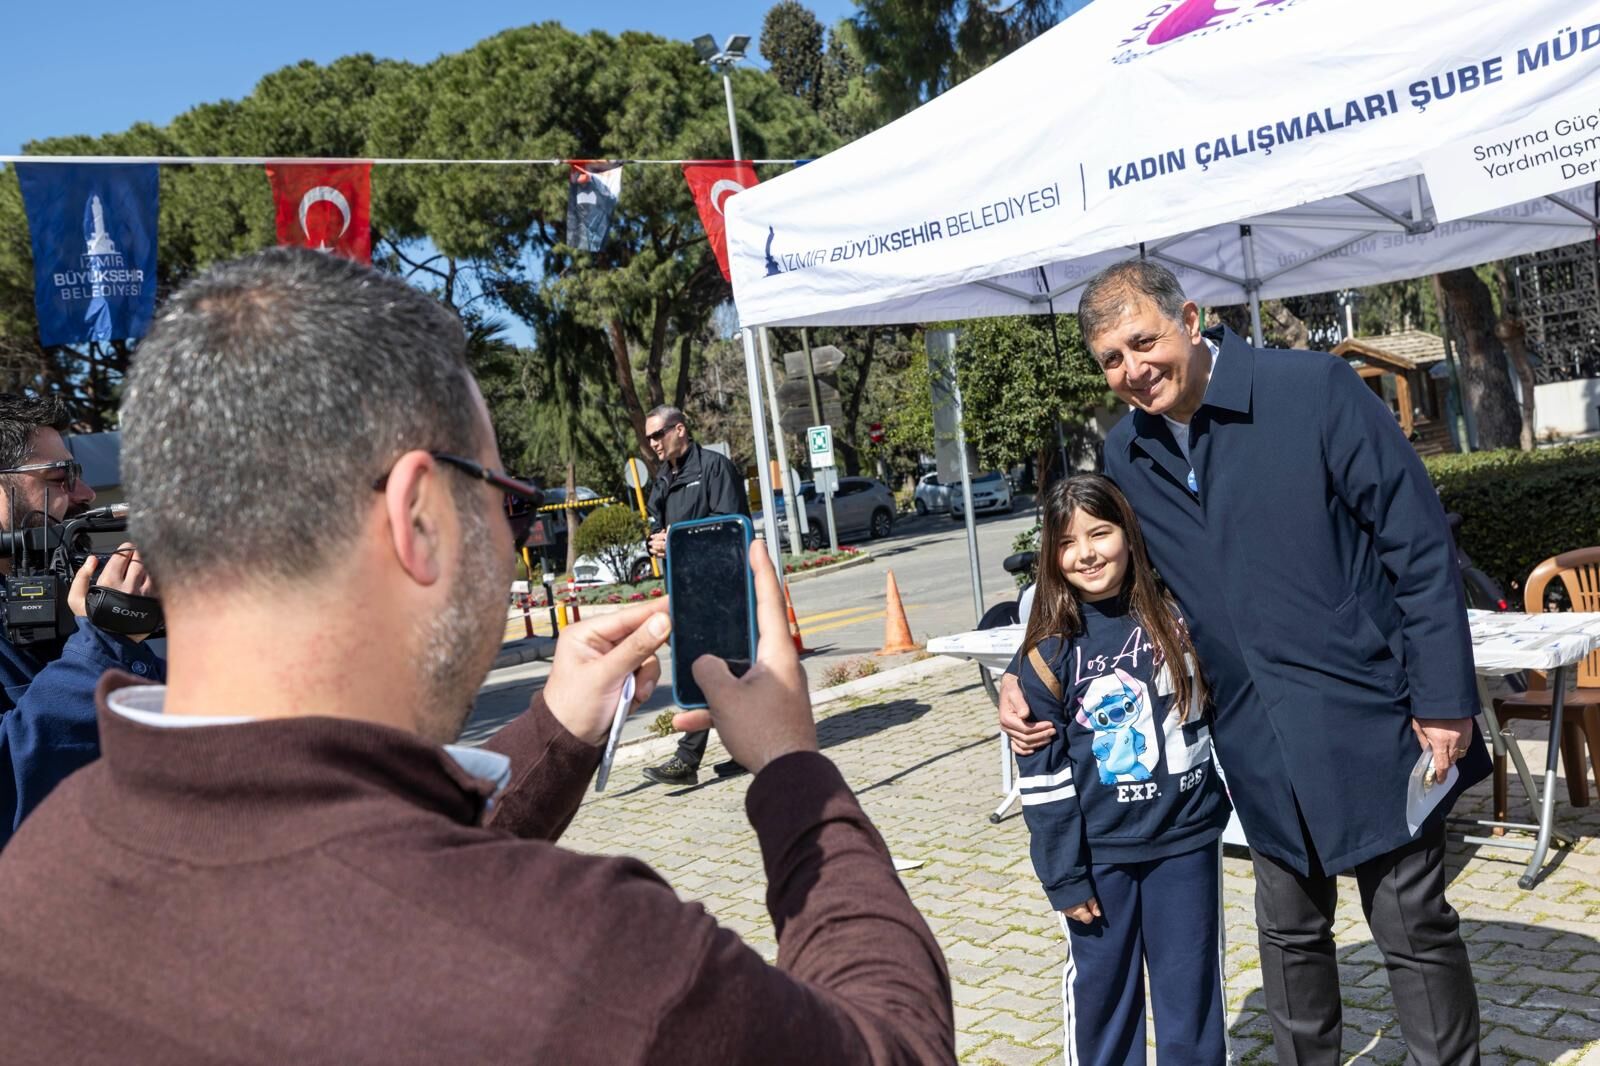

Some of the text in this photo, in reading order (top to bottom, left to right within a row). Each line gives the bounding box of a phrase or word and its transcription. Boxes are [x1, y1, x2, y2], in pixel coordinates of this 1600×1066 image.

[946, 182, 1060, 237] BELEDİYESİ
[1108, 148, 1186, 190] KADIN
[1195, 89, 1398, 171] ÇALIŞMALARI
[1408, 56, 1503, 114] ŞUBE
[1517, 23, 1600, 75] MÜD
[1473, 108, 1600, 161] Smyrna Güç
[1483, 136, 1600, 179] Yardımlaşm
[1561, 159, 1600, 180] Der
[112, 606, 149, 619] SONY
[1117, 782, 1162, 803] EXP.
